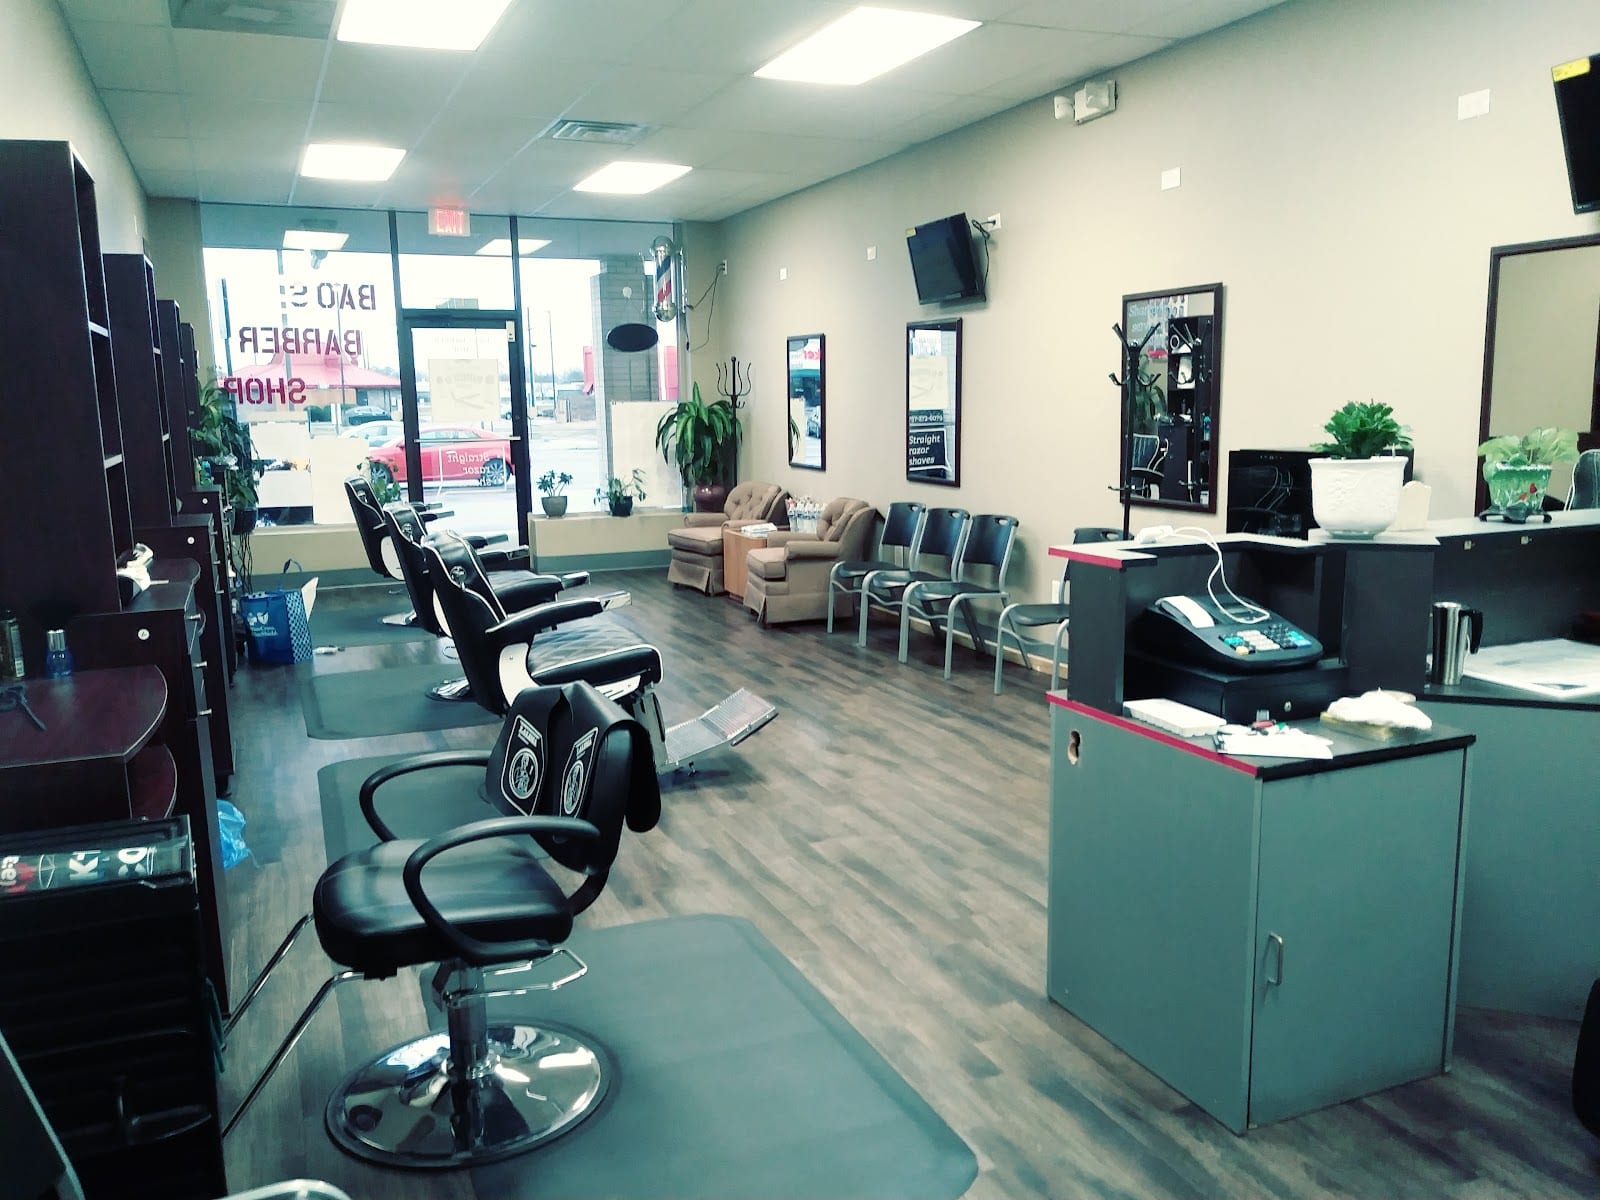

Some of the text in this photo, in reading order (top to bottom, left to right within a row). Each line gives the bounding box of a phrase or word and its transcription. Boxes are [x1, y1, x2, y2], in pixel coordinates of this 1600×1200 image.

[435, 209, 464, 234] EXIT
[909, 434, 940, 446] Straight
[909, 446, 930, 456] razor
